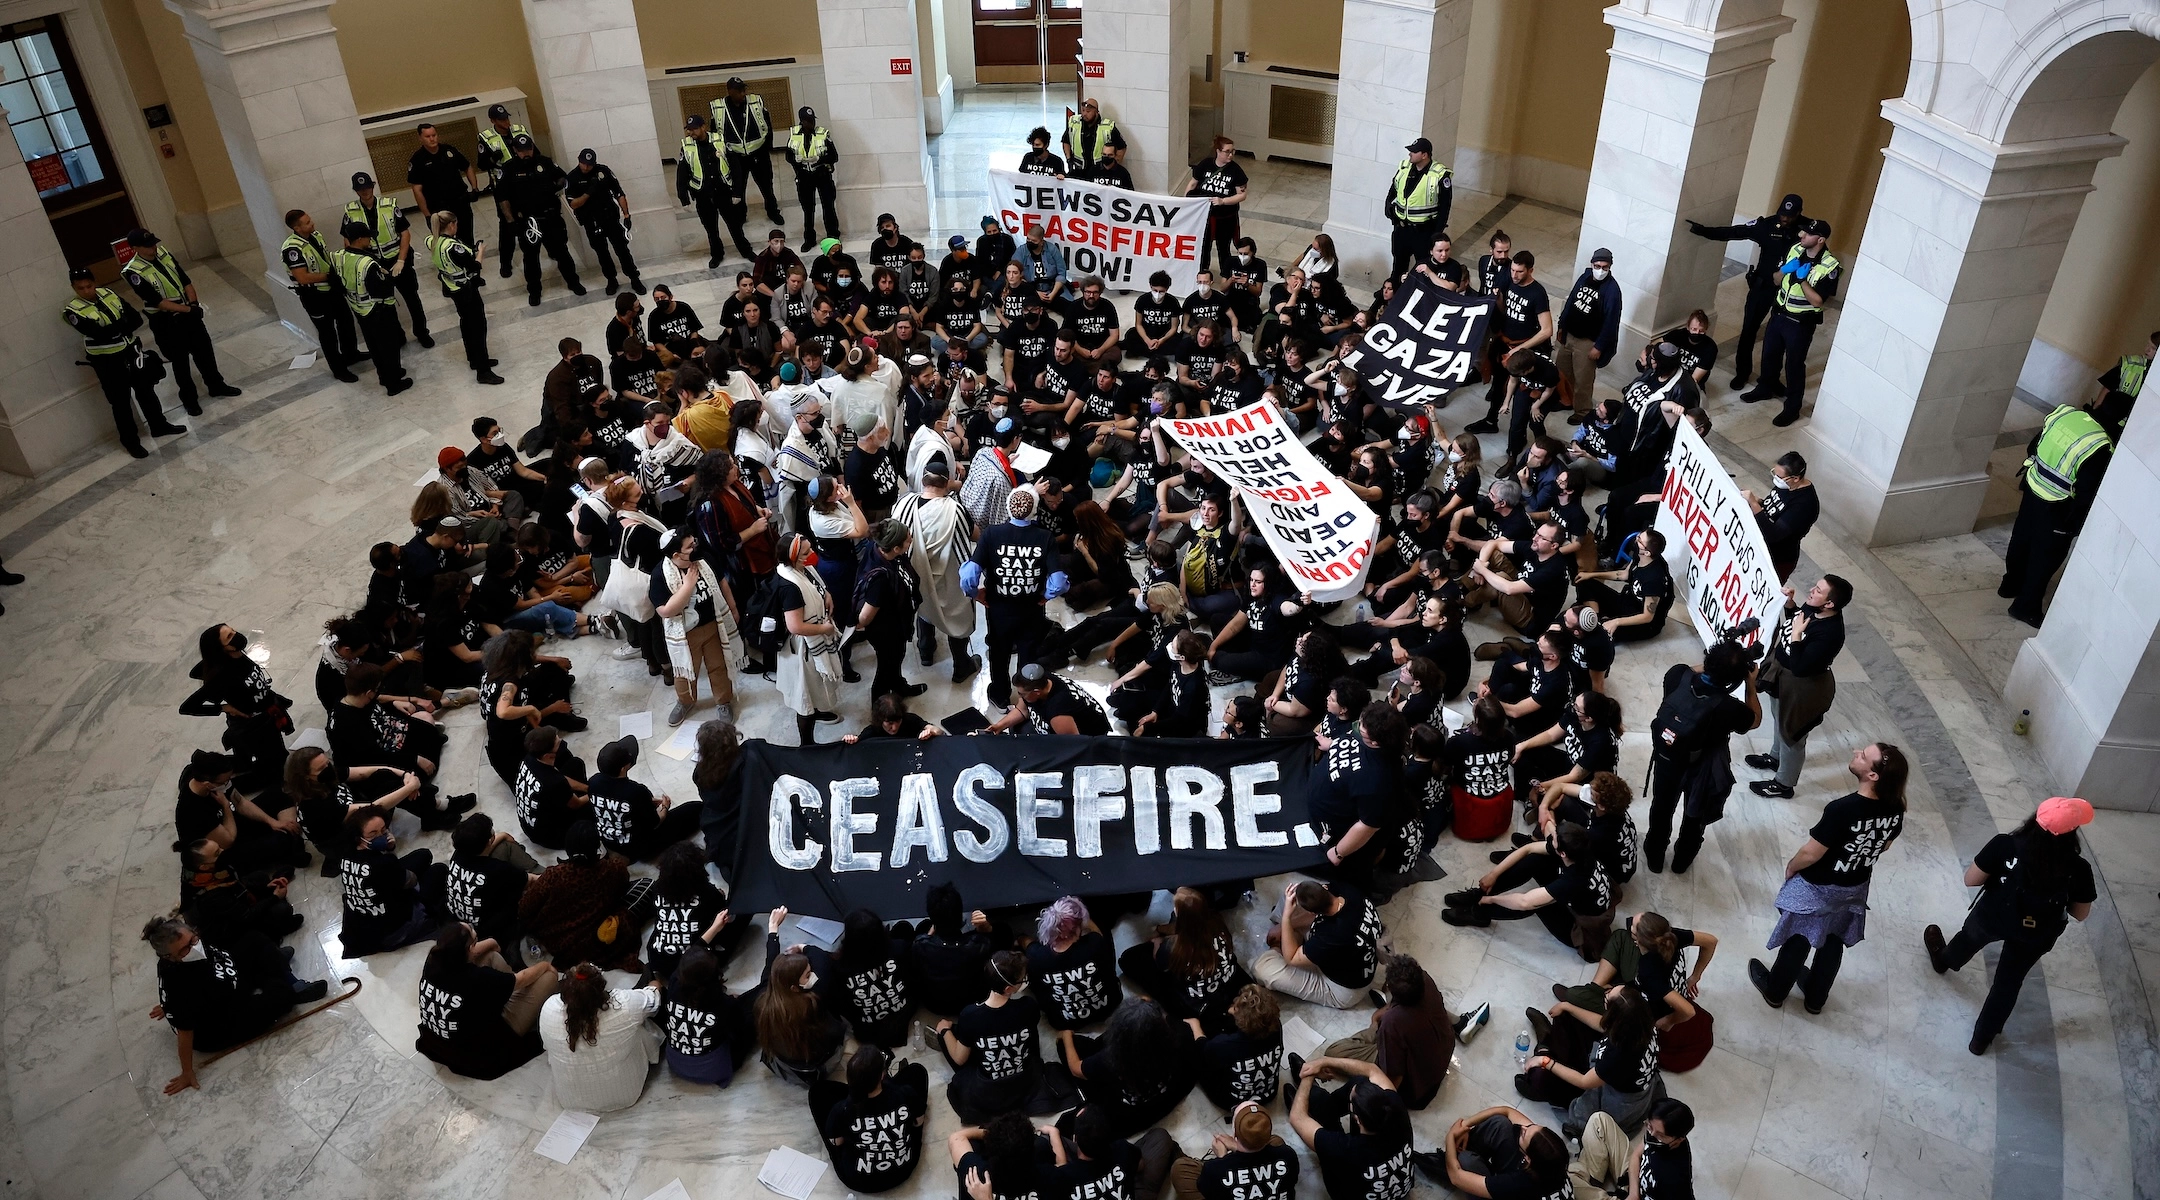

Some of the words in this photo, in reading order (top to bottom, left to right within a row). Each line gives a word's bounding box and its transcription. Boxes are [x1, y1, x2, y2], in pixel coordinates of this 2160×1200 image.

[892, 62, 911, 72] EXIT
[1085, 65, 1103, 75] EXIT
[1202, 183, 1229, 195] NAME
[1014, 185, 1102, 217] JEWS
[1110, 198, 1180, 227] SAY
[1001, 210, 1196, 260] CEASEFIRE
[1520, 298, 1528, 306] IN
[660, 320, 678, 330] NOT
[678, 317, 687, 325] IN
[1398, 288, 1489, 345] LET
[668, 323, 687, 334] OUR
[1363, 322, 1471, 383] GAZA
[1691, 354, 1699, 363] IN
[628, 373, 642, 381] NOT
[634, 378, 653, 388] OUR
[1046, 364, 1058, 378] NOT
[1059, 376, 1068, 386] IN
[1295, 381, 1302, 391] IN
[1633, 388, 1648, 405] OUR
[1090, 402, 1109, 415] OUR
[597, 422, 613, 437] NOT
[1174, 406, 1273, 438] LIVING
[604, 428, 626, 442] OUR
[1234, 428, 1287, 454] FOR
[1182, 439, 1234, 456] THE
[483, 462, 500, 473] NOT
[501, 456, 510, 465] IN
[873, 461, 885, 480] NOT
[1206, 452, 1291, 474] HELL
[1132, 469, 1150, 478] OUR
[1229, 472, 1302, 488] LIKE
[1270, 502, 1319, 522] AND
[1660, 467, 1719, 571] NEVER
[1559, 518, 1567, 528] IN
[1678, 441, 1726, 518] PHILLY
[1724, 508, 1755, 574] JEWS
[1751, 567, 1774, 616] SAY
[997, 545, 1042, 558] JEWS
[1297, 540, 1354, 564] THE
[1397, 540, 1413, 560] OUR
[1399, 530, 1413, 546] NOT
[1412, 543, 1421, 554] IN
[538, 558, 557, 570] NOT
[996, 568, 1041, 577] CEASE
[1001, 558, 1036, 568] SAY
[1687, 556, 1699, 589] IS
[996, 584, 1038, 596] NOW
[1002, 577, 1034, 585] FIRE
[245, 666, 259, 687] NOT
[1339, 739, 1350, 769] OUR
[1351, 738, 1360, 755] OT
[1329, 737, 1340, 782] NAME
[1351, 757, 1362, 771] IN
[1464, 750, 1510, 766] JEWS
[1470, 764, 1502, 776] SAY
[590, 795, 630, 813] JEWS
[769, 761, 1320, 873] CEASEFIRE.
[1850, 814, 1901, 833] JEWS
[1855, 829, 1893, 846] SAY
[341, 875, 363, 886] SAY
[448, 860, 486, 885] JEWS
[447, 875, 476, 897] SAY
[659, 908, 692, 921] SAY
[656, 922, 699, 932] CEASE
[660, 932, 691, 944] FIRE
[846, 959, 897, 989] JEWS
[1042, 962, 1097, 984] JEWS
[420, 979, 463, 1009] JEWS
[855, 975, 894, 999] SAY
[1054, 977, 1092, 995] SAY
[420, 994, 452, 1020] SAY
[665, 1000, 717, 1026] JEWS
[1062, 995, 1108, 1020] NOW
[667, 1017, 707, 1038] SAY
[976, 1028, 1030, 1050] JEWS
[985, 1044, 1024, 1062] SAY
[1232, 1045, 1282, 1073] JEWS
[1240, 1062, 1279, 1083] SAY
[851, 1105, 909, 1132] JEWS
[861, 1123, 904, 1144] SAY
[856, 1151, 912, 1174] NOW
[1363, 1143, 1412, 1180] JEWS
[1070, 1165, 1125, 1200] JEWS
[1222, 1160, 1288, 1186] JEWS
[1373, 1160, 1413, 1192] SAY
[1232, 1178, 1281, 1200] SAY
